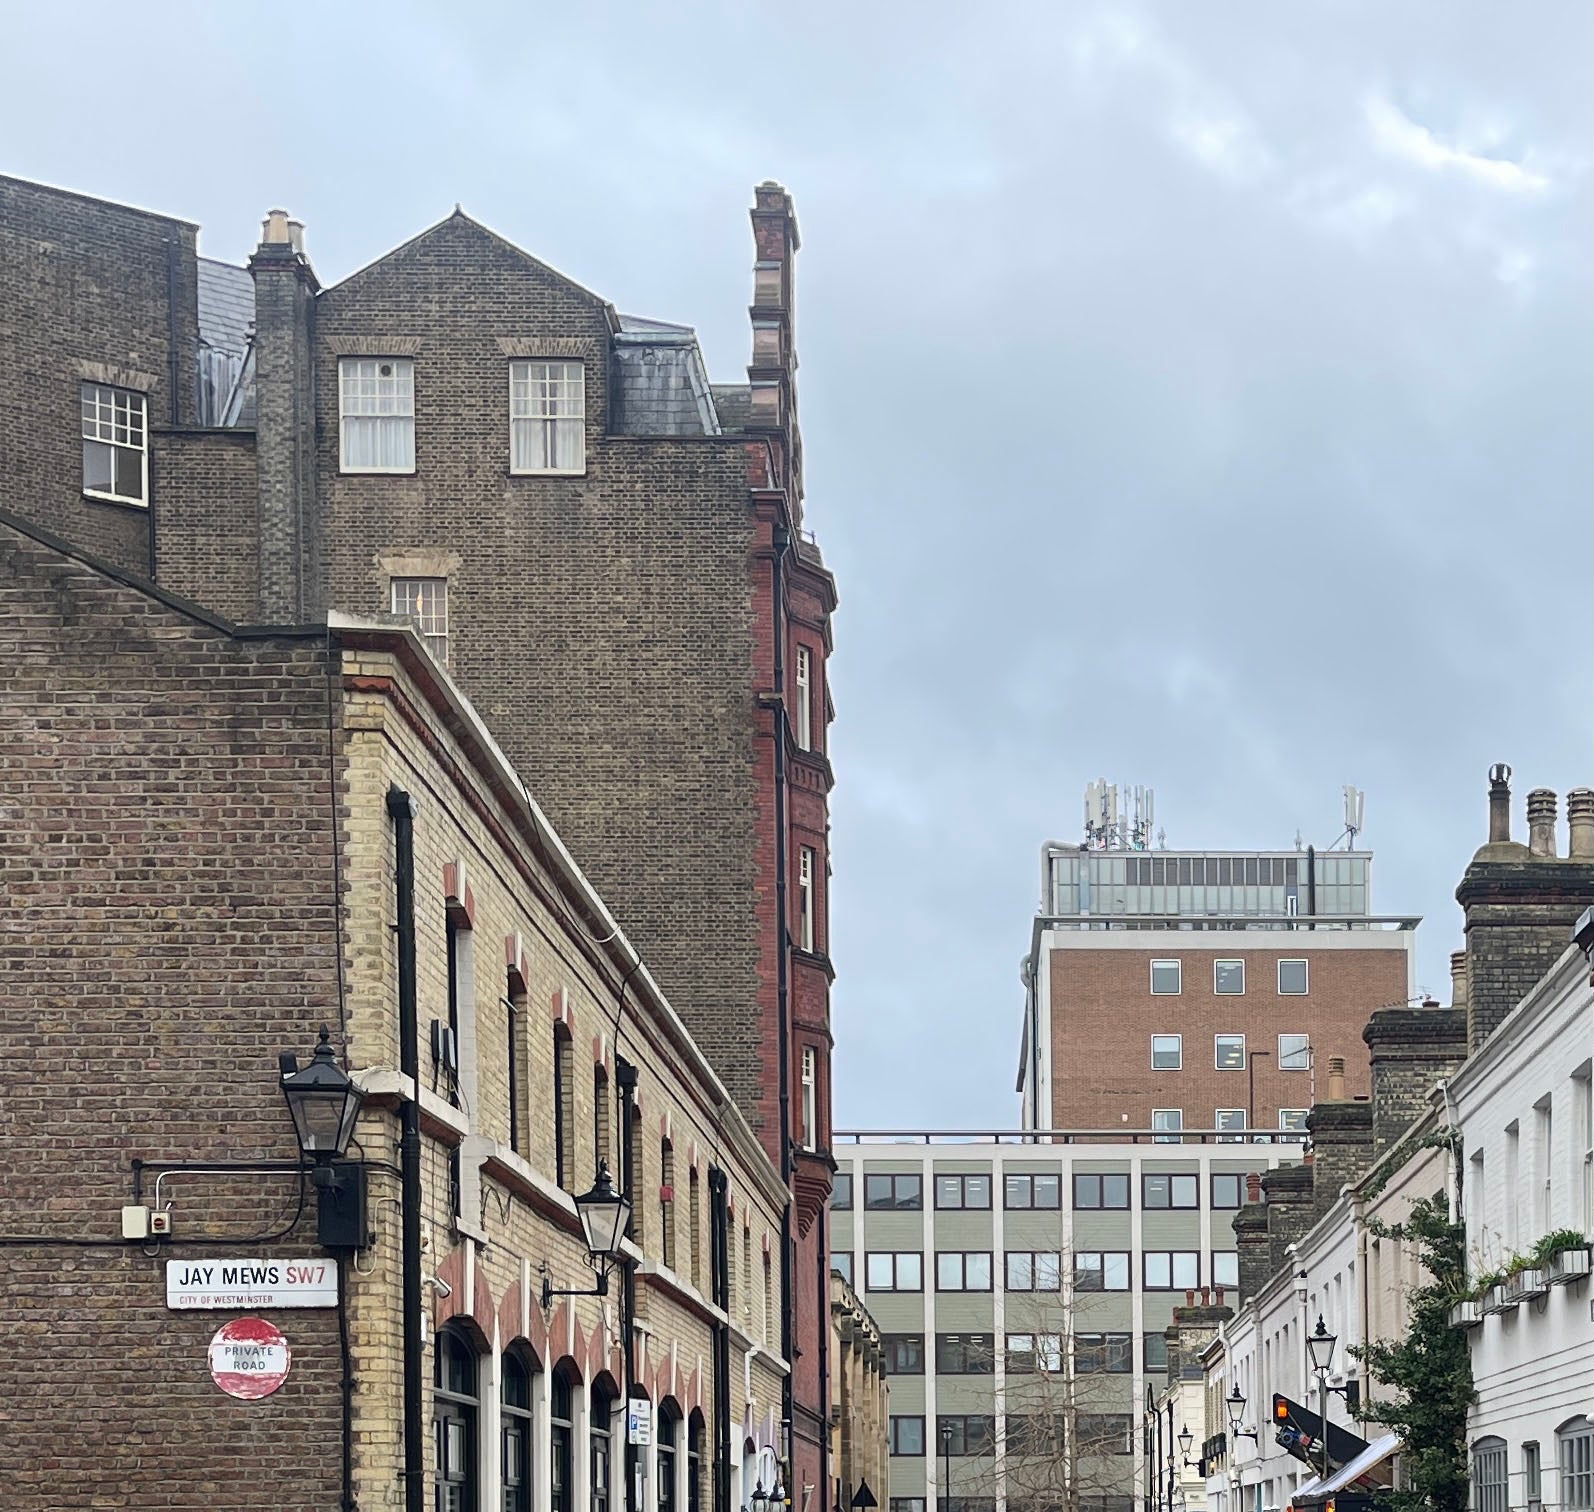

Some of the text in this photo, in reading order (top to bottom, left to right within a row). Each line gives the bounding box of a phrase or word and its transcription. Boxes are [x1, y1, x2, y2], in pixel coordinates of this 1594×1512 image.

[180, 1266, 326, 1285] JAY MEWS SW7
[179, 1295, 273, 1304] CITY OF WESTMINSTER
[225, 1346, 273, 1355] PRIVATE
[234, 1361, 265, 1370] ROAD
